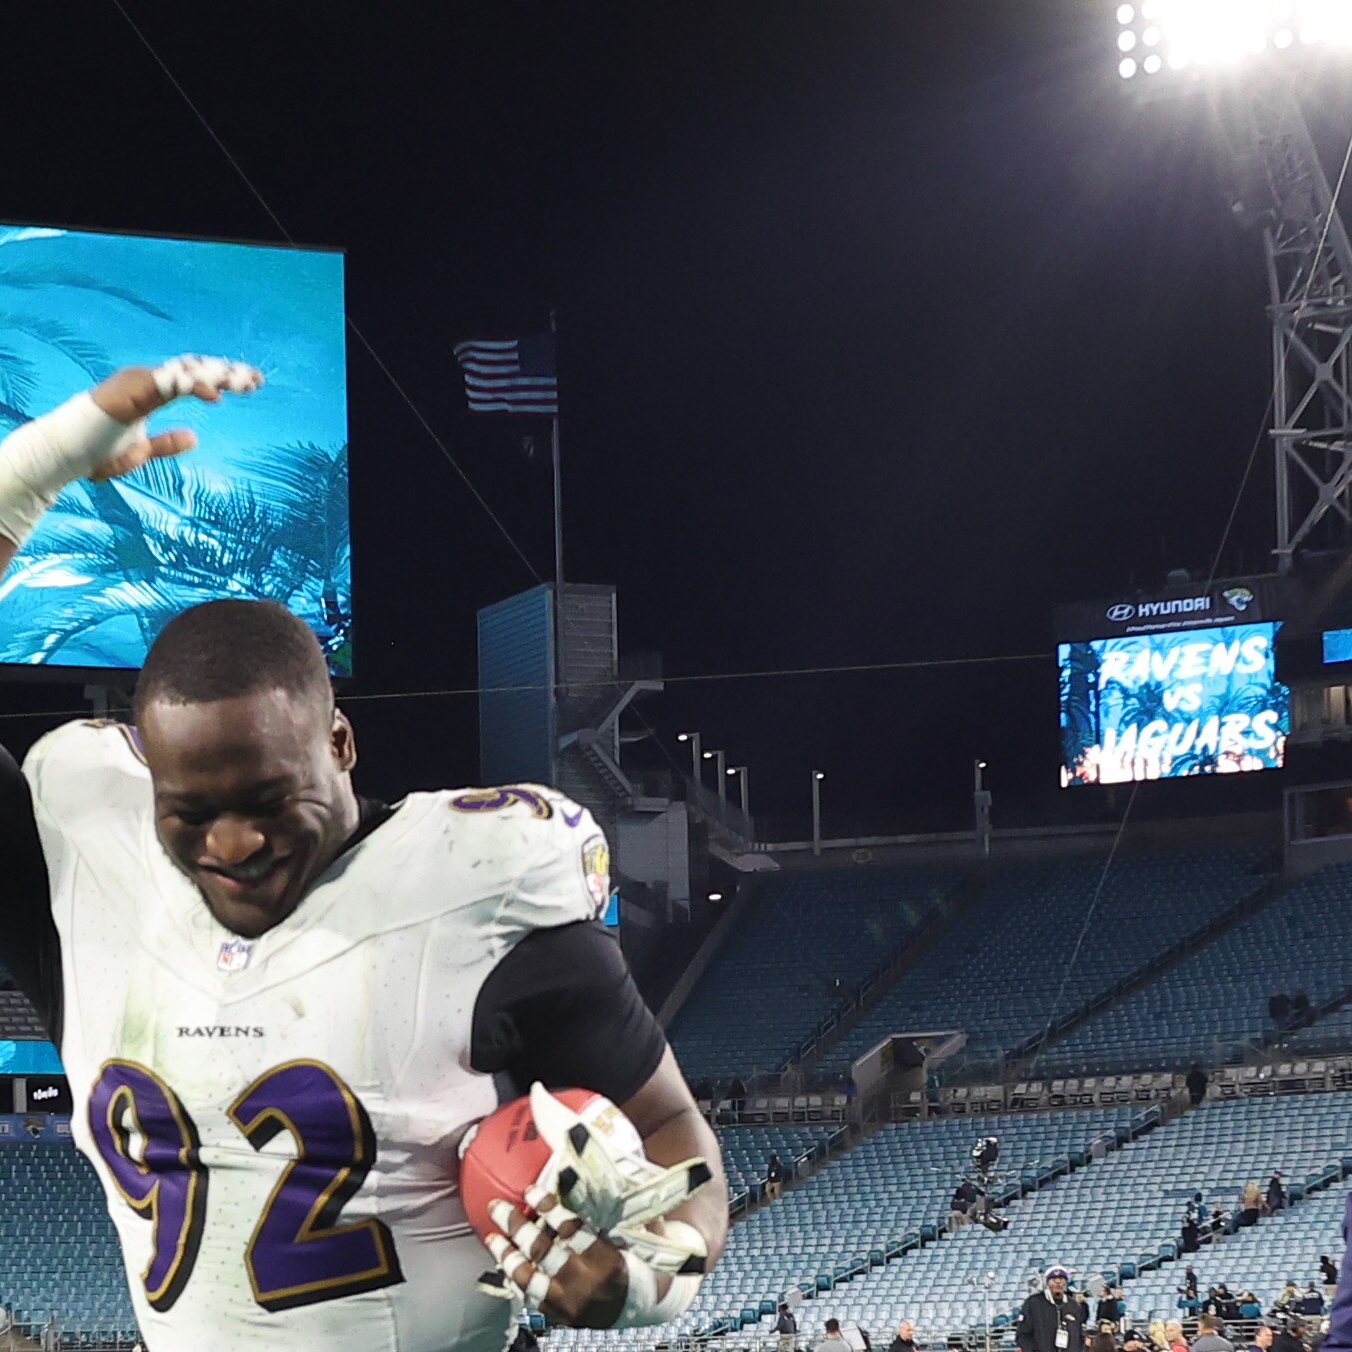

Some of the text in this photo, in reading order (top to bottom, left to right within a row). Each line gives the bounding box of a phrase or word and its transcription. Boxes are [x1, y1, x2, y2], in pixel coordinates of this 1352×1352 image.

[1138, 596, 1211, 618] HYUNDAI
[1098, 635, 1269, 691] RAVENS
[1095, 710, 1280, 770] JAGUARS
[176, 1025, 266, 1038] RAVENS
[87, 1057, 406, 1313] 92
